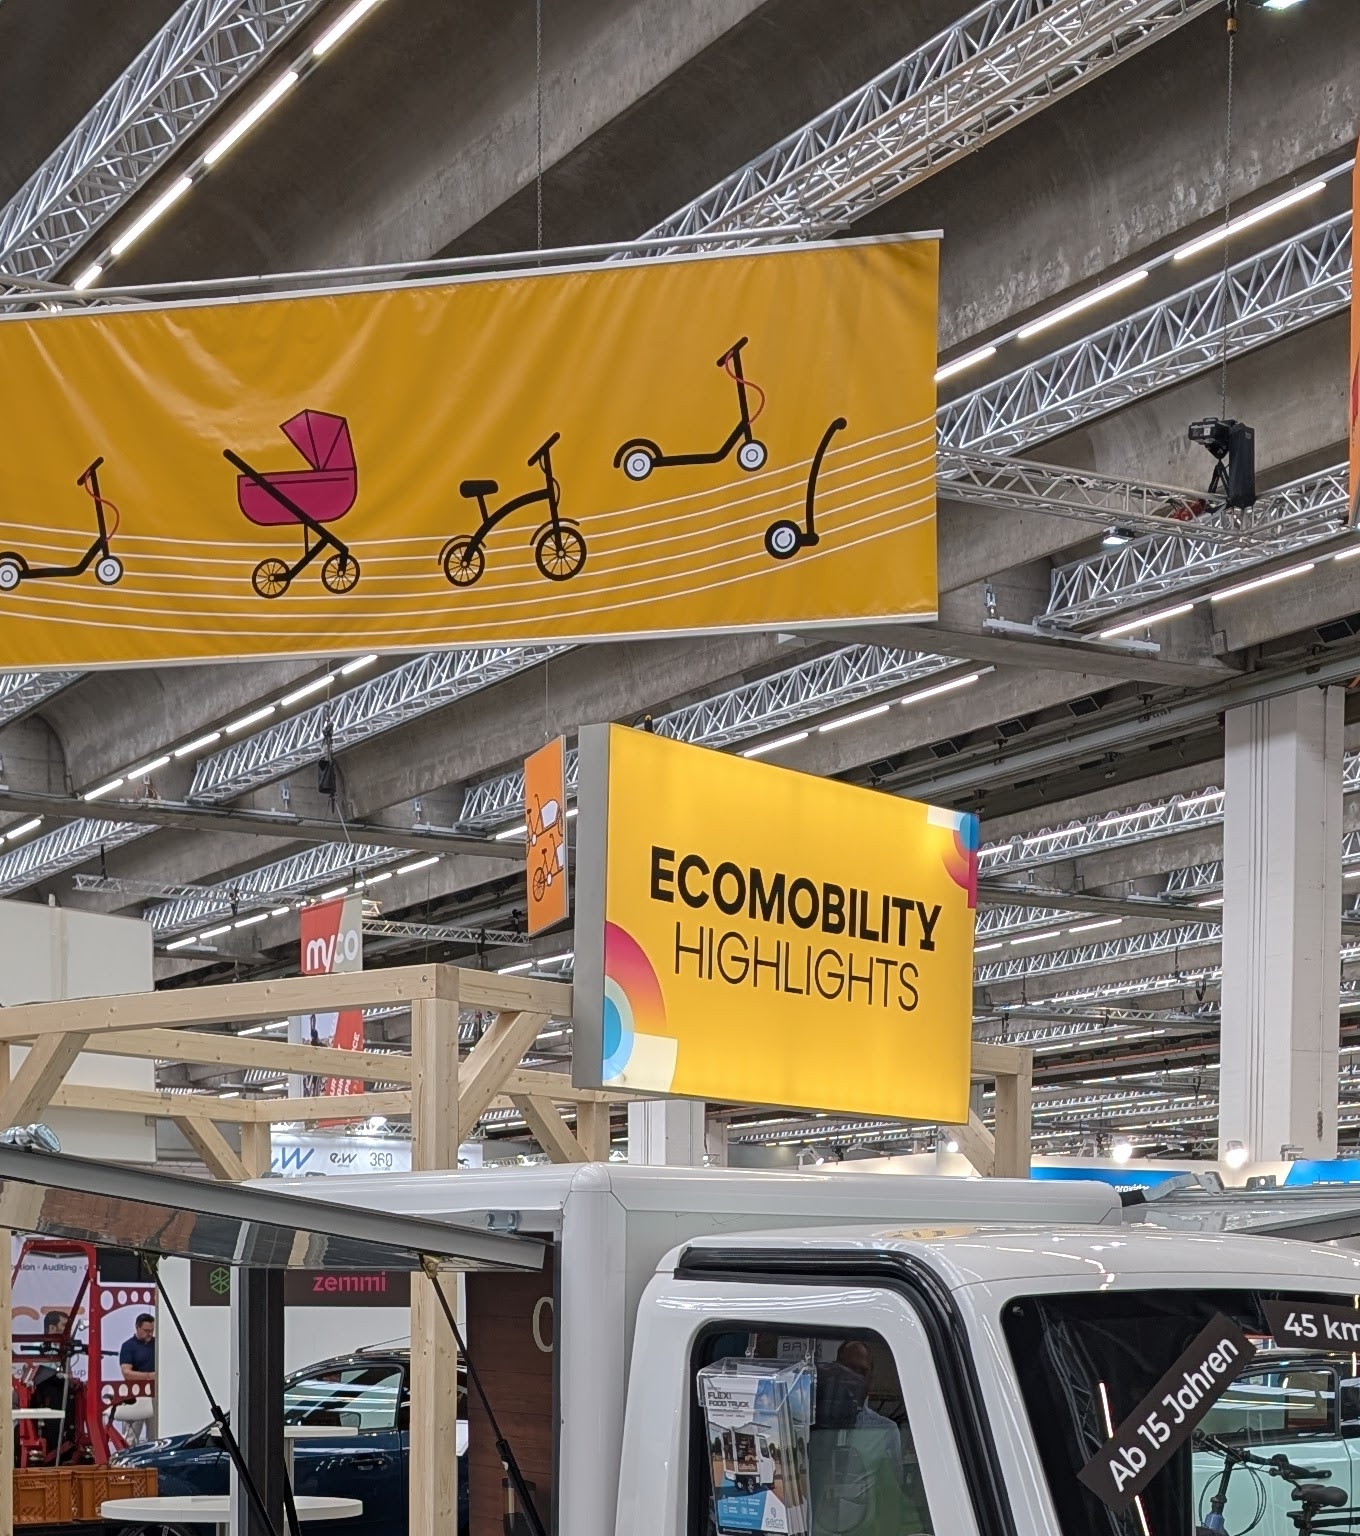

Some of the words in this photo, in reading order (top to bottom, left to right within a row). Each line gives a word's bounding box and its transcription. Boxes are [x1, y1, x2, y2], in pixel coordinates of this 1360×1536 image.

[650, 845, 942, 952] ECOMOBILITY
[674, 921, 920, 1012] HIGHLIGHTS
[42, 1263, 77, 1273] Auditing
[313, 1270, 387, 1293] zemmi
[1283, 1312, 1318, 1338] 45
[1108, 1446, 1147, 1493] Ab
[1137, 1411, 1171, 1450] 15
[1161, 1337, 1240, 1424] Jahren
